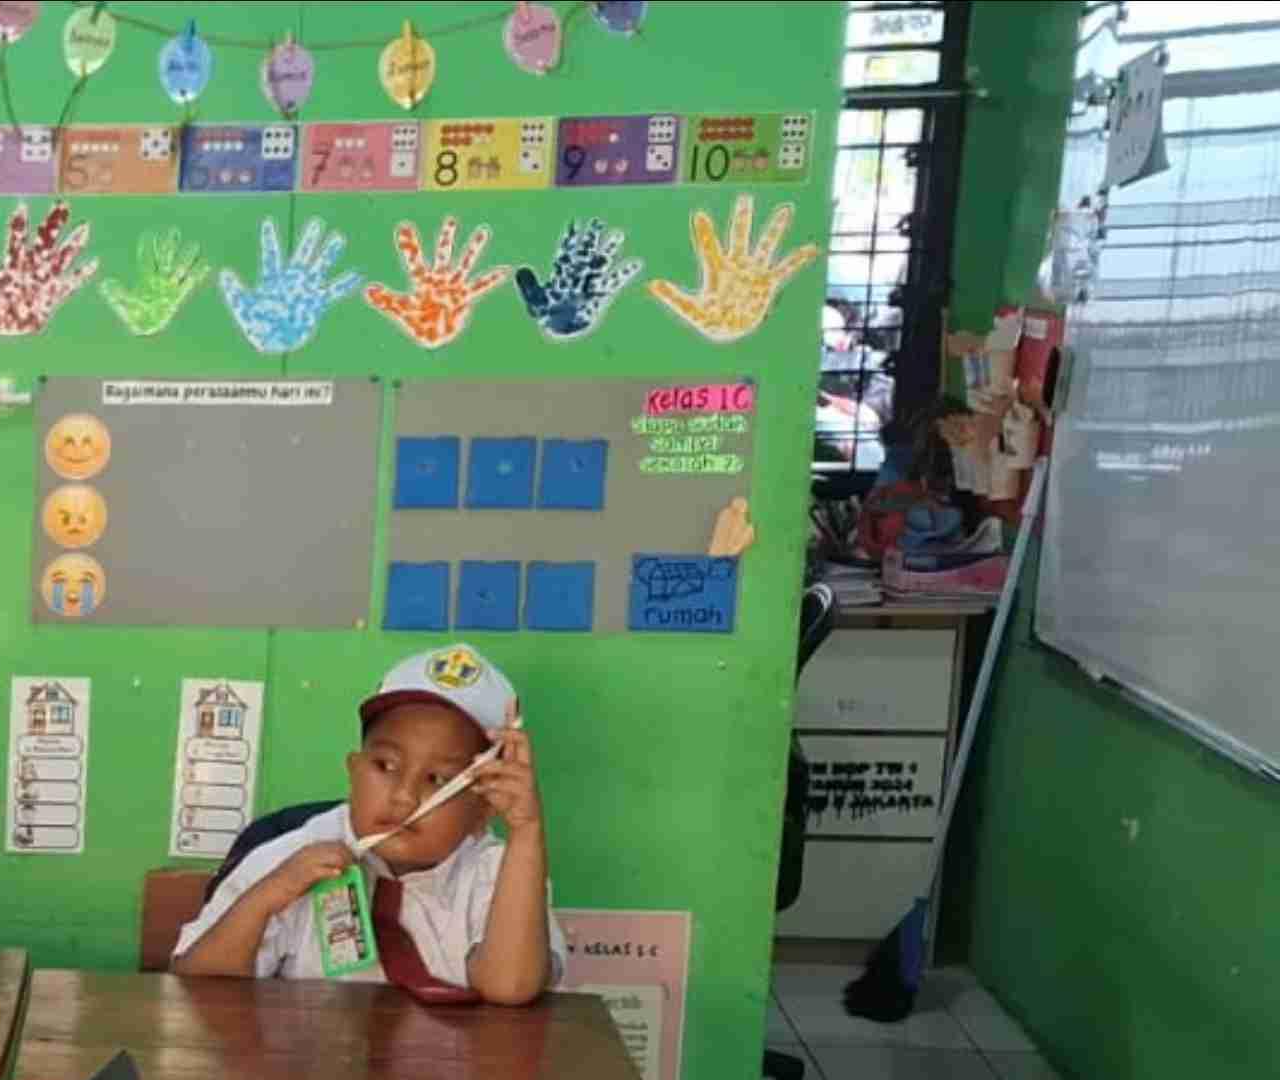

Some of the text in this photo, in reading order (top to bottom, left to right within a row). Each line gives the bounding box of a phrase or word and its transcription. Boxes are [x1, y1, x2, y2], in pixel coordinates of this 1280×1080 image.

[63, 153, 90, 190] 5
[311, 147, 333, 188] 7
[433, 149, 459, 187] 8
[564, 144, 587, 183] 9
[690, 144, 730, 182] 10
